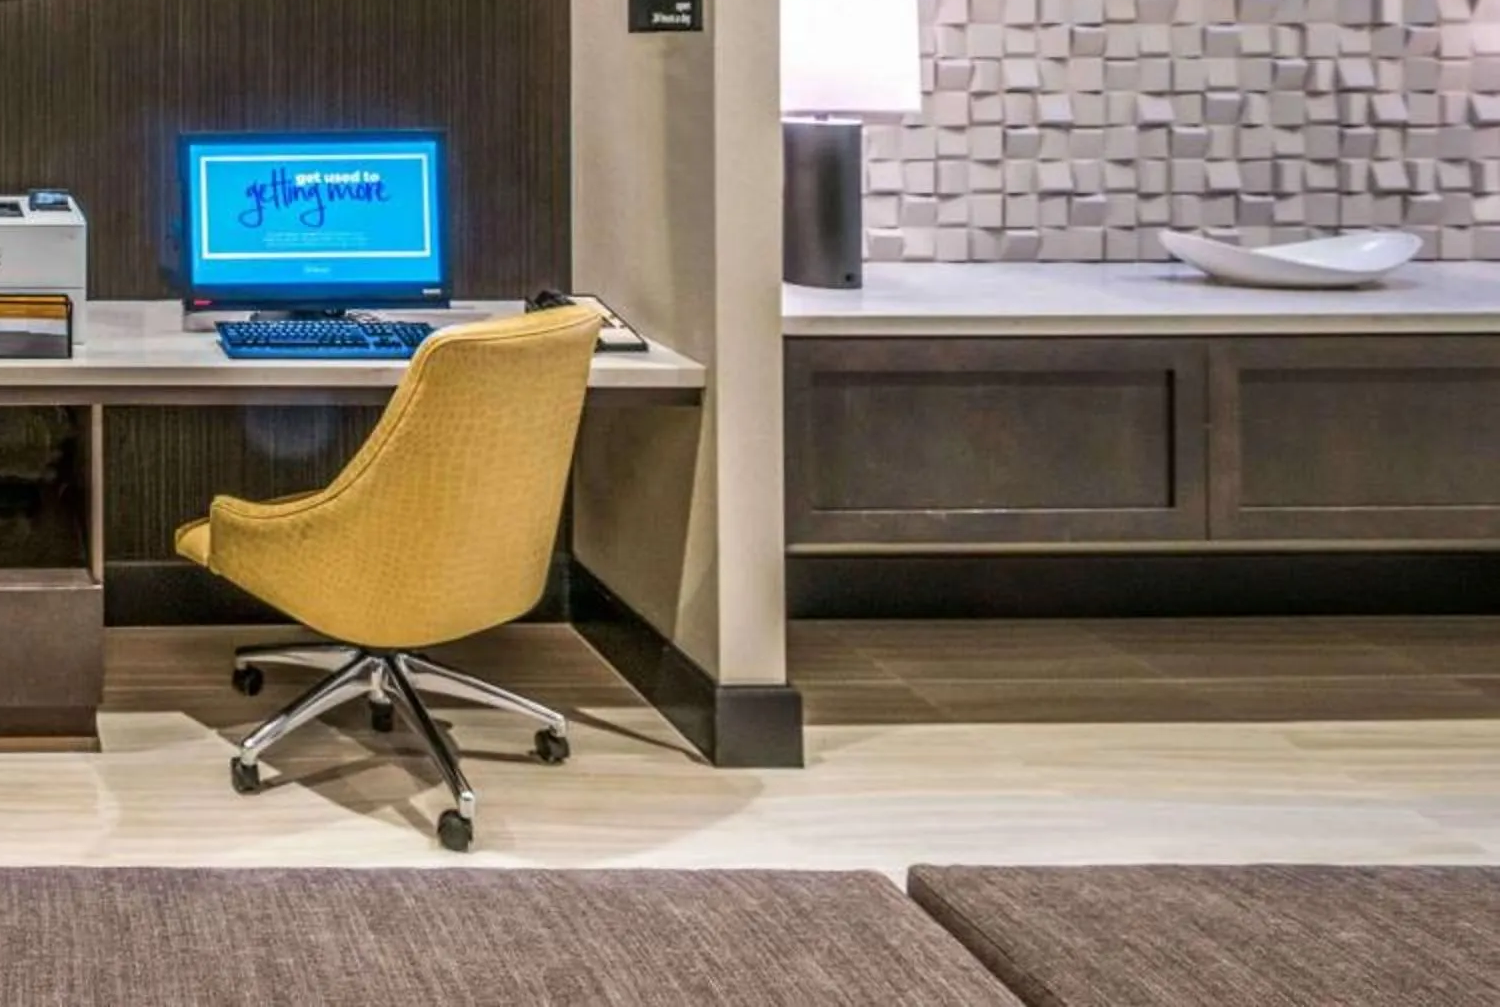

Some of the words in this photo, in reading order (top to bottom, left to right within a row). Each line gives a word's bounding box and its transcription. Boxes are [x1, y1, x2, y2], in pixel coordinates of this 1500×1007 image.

[237, 167, 326, 229] getting
[295, 170, 322, 187] get
[363, 169, 381, 184] to
